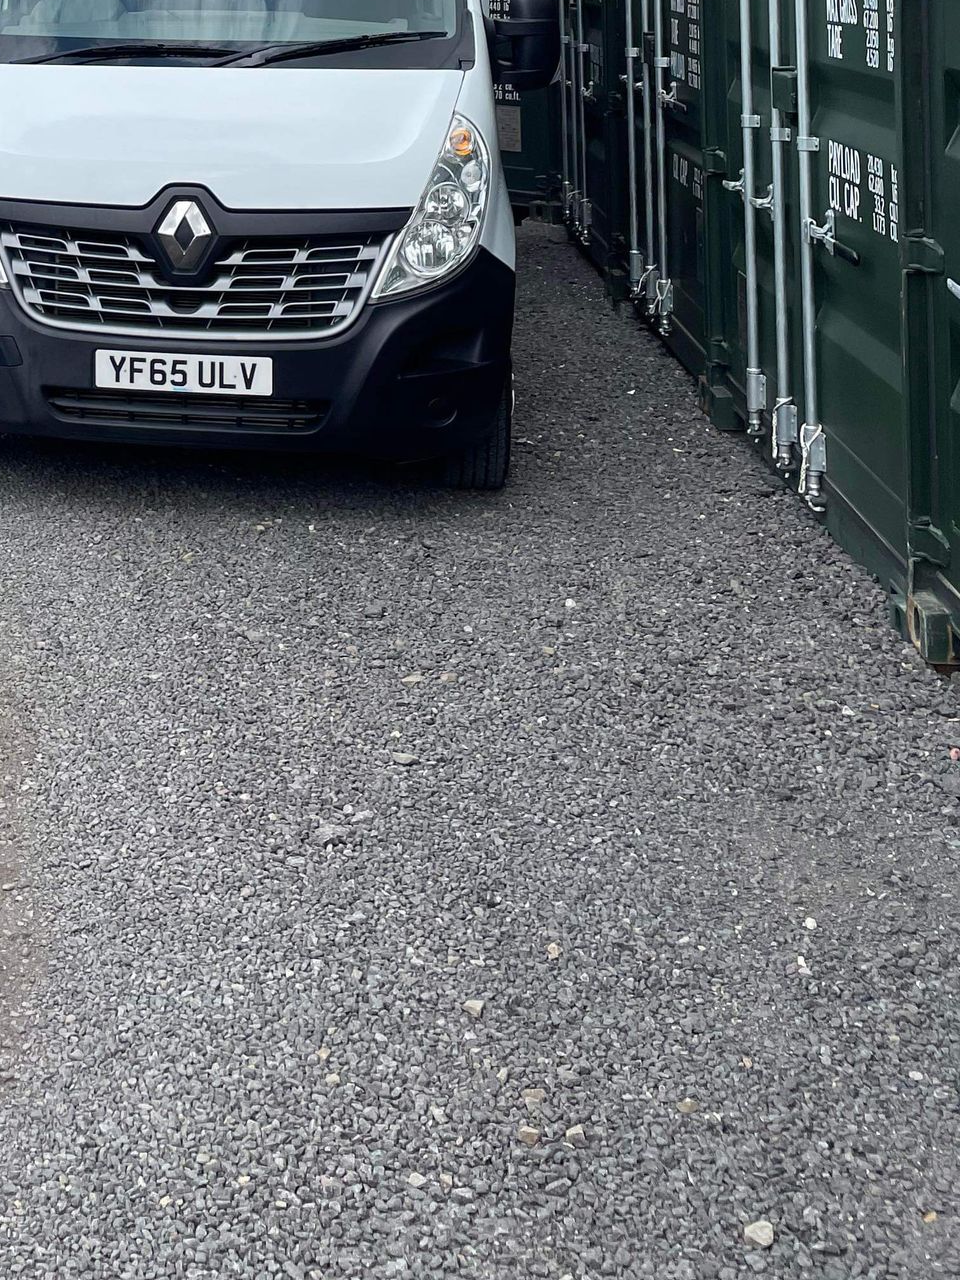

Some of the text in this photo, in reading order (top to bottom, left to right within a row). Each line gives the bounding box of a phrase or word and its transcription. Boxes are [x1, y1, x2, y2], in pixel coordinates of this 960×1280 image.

[827, 24, 843, 59] TARE
[828, 139, 861, 185] PAYLOAD
[829, 176, 842, 212] CU.
[844, 182, 863, 223] CAP.
[109, 355, 257, 390] YF65 ULV
